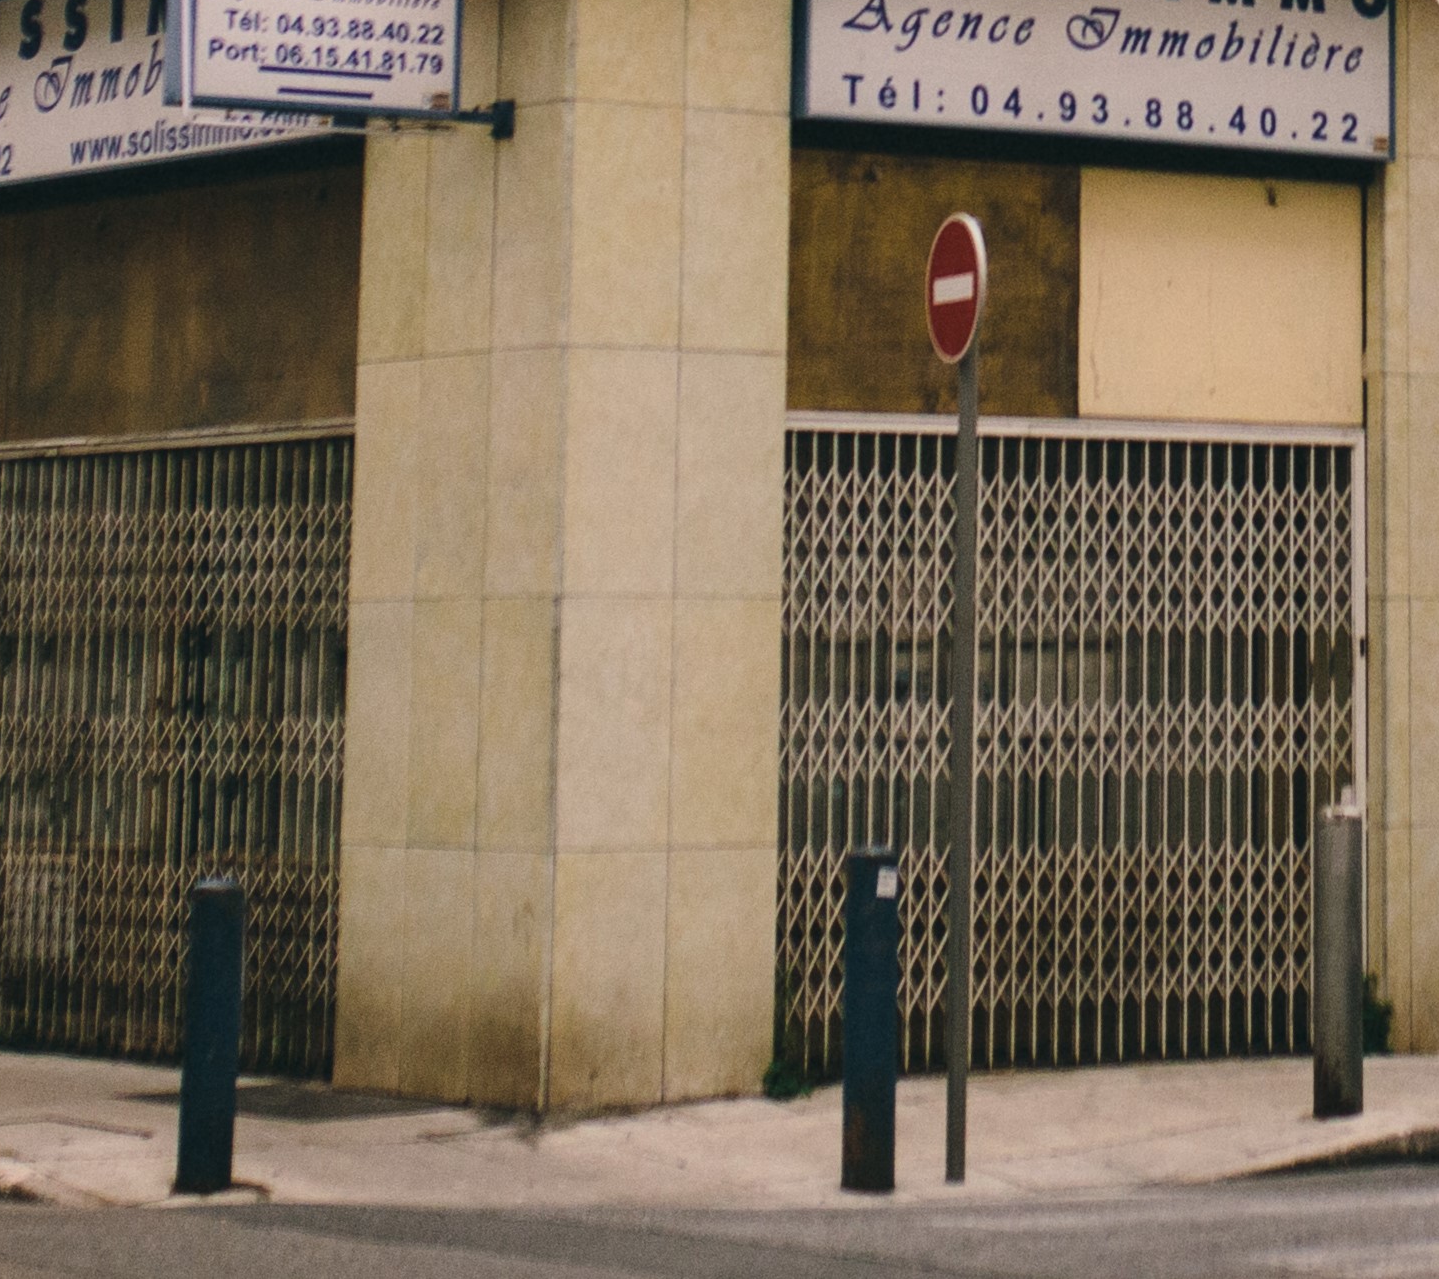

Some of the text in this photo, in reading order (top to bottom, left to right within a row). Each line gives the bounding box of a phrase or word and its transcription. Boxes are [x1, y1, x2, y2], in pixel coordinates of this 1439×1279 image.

[224, 9, 445, 46] Tél: 04.93.88.40.22
[1065, 6, 1365, 74] Immobilière
[207, 39, 444, 76] Port: 06.15.41.81.79
[841, 72, 1359, 144] Tél: 04.93.88.40.22
